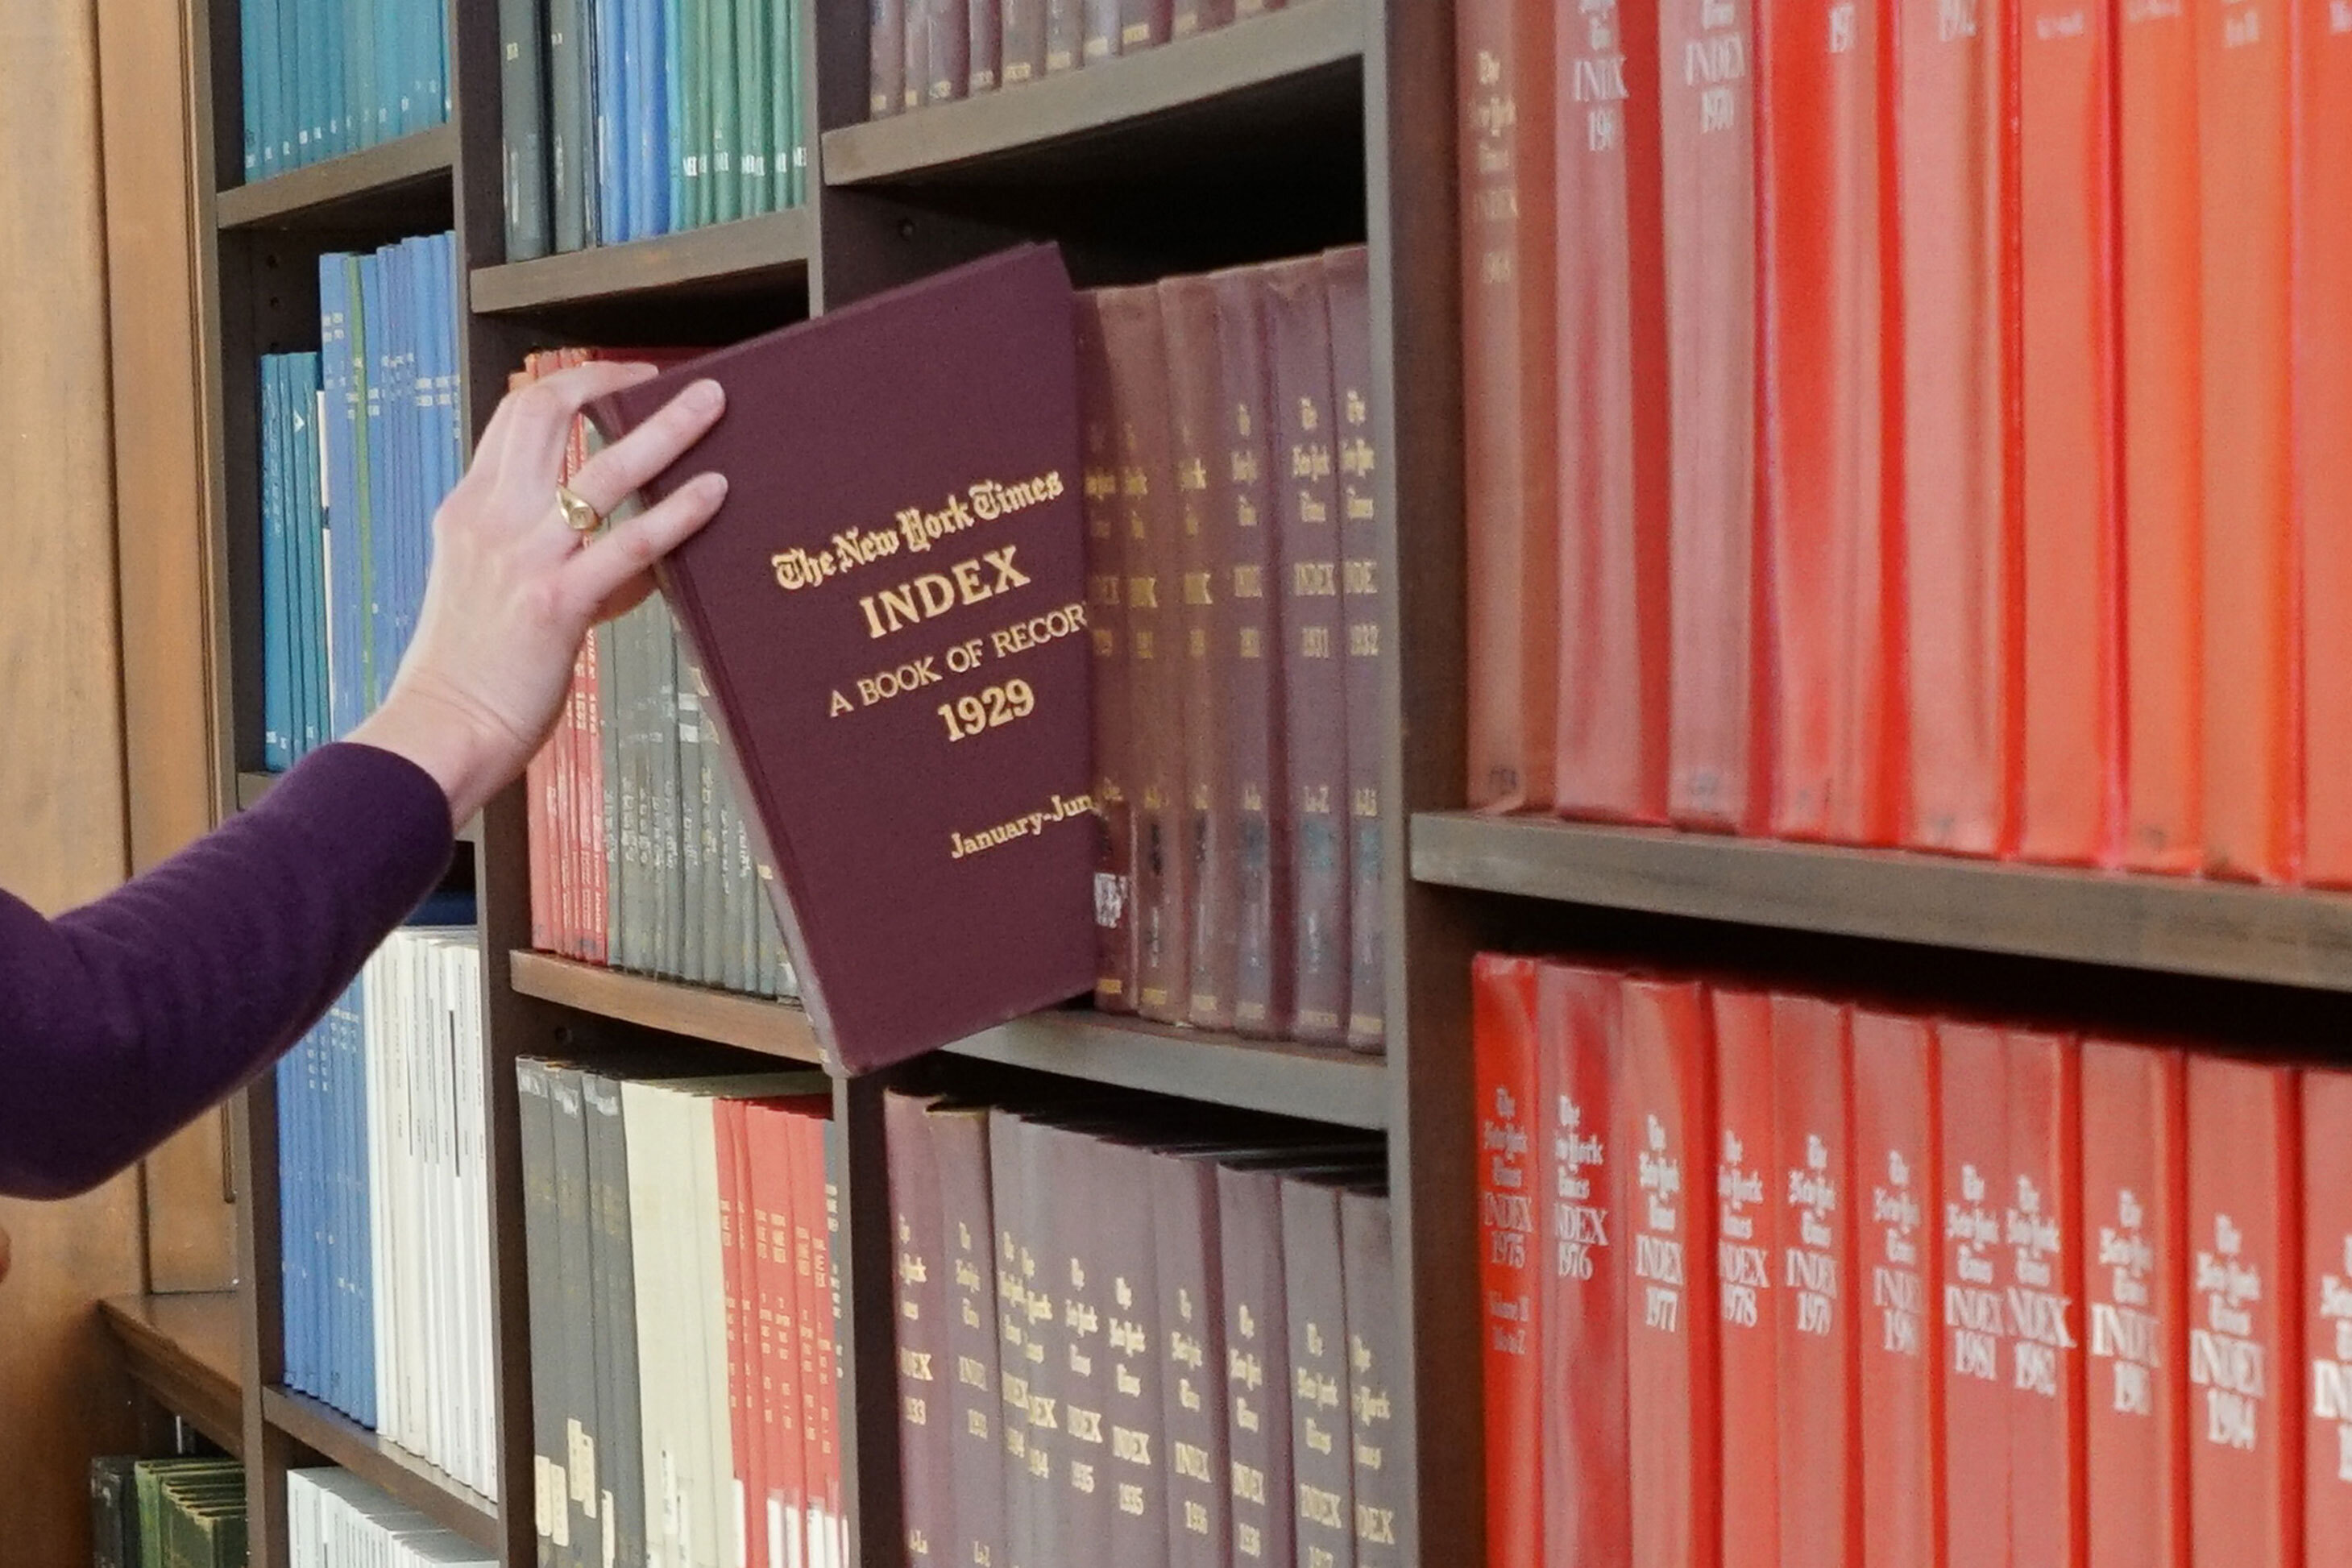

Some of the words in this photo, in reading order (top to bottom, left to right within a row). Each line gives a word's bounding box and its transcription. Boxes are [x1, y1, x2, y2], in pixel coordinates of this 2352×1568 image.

[771, 548, 836, 591] The
[832, 525, 900, 574] New
[895, 493, 974, 553] York
[969, 470, 1064, 521] Times
[860, 545, 1031, 640] INDEX
[828, 689, 854, 718] A
[857, 655, 943, 707] BOOK
[946, 638, 984, 674] OF
[990, 600, 1089, 659] RECOR
[937, 678, 1035, 743] 1929
[951, 794, 1101, 860] January-Jun
